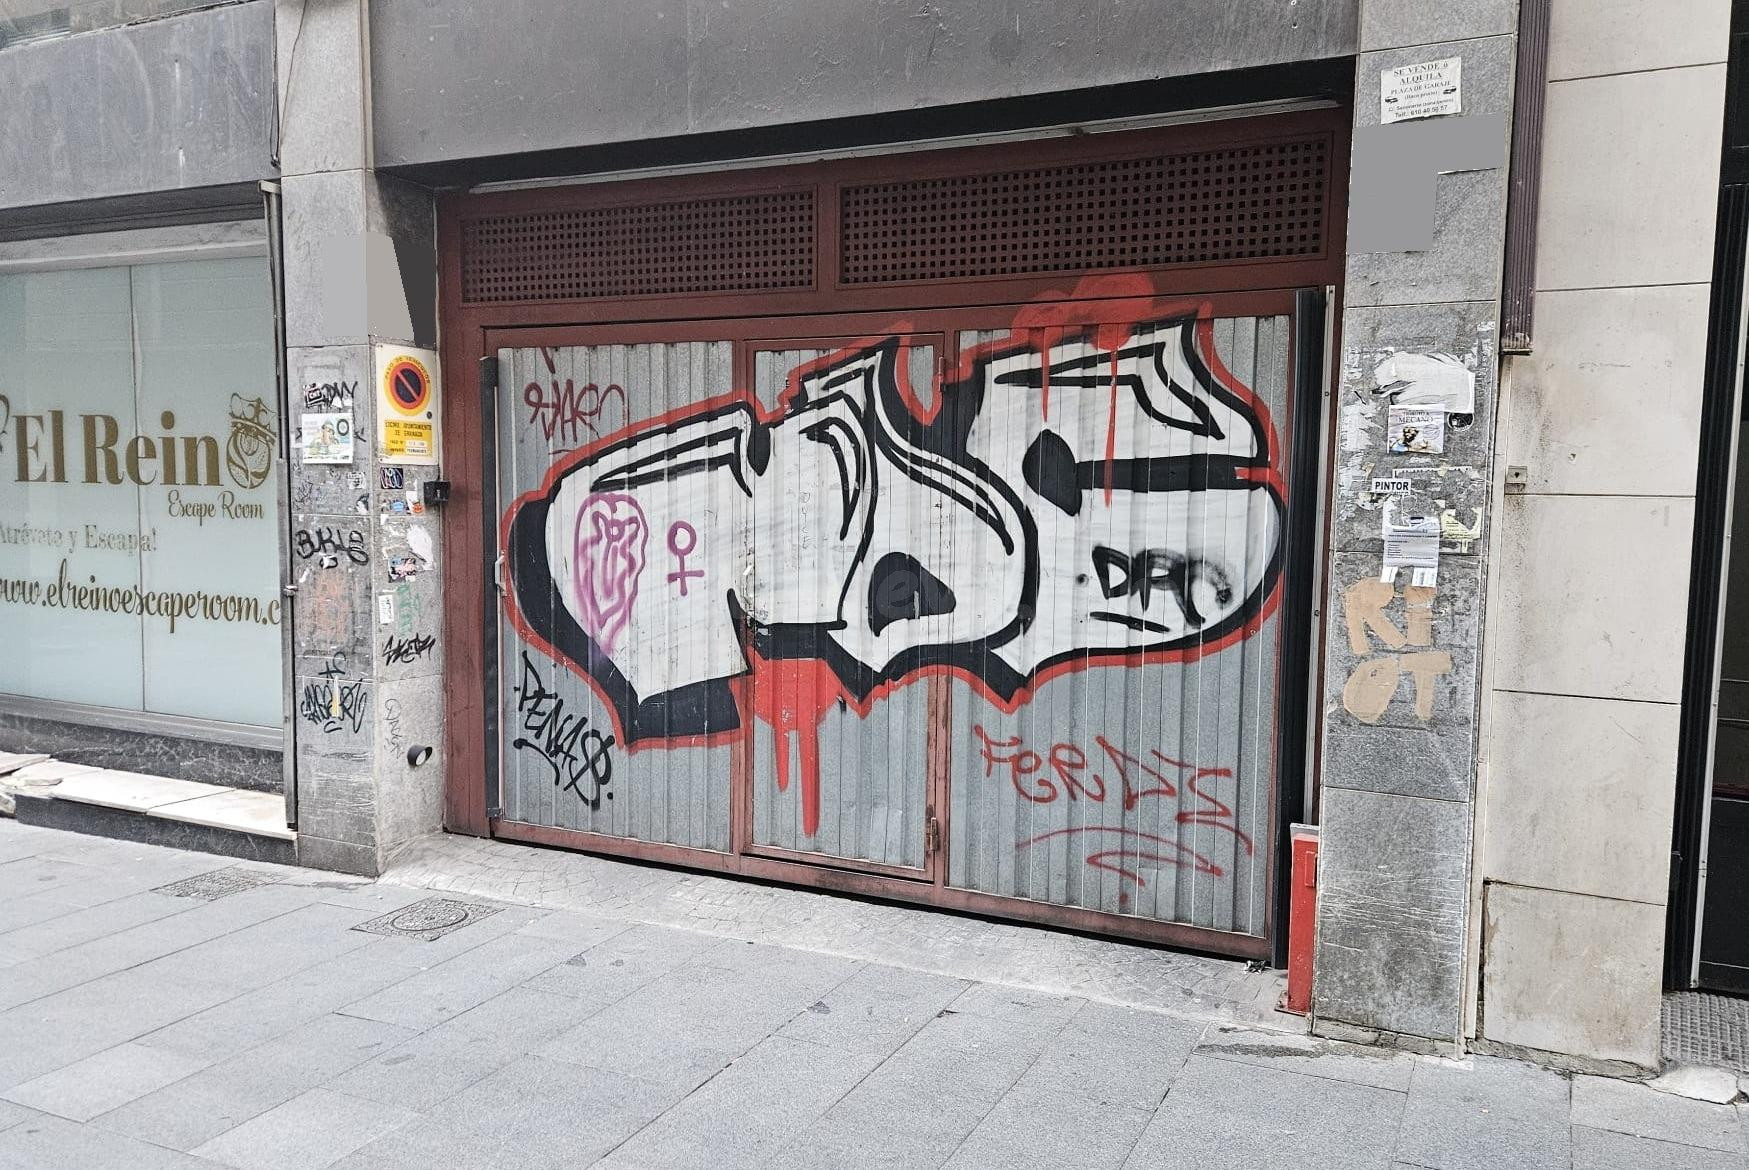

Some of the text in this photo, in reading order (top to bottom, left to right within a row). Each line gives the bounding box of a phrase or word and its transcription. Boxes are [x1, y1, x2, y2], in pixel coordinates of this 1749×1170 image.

[1394, 69, 1403, 77] SE
[1408, 63, 1440, 73] VENDE
[1400, 72, 1443, 85] ALQUILA
[1391, 86, 1412, 95] PLAZA
[12, 410, 68, 484] El
[1375, 481, 1409, 496] PINTOR
[168, 489, 216, 526] Escape
[218, 490, 264, 519] Room
[68, 529, 78, 554] y
